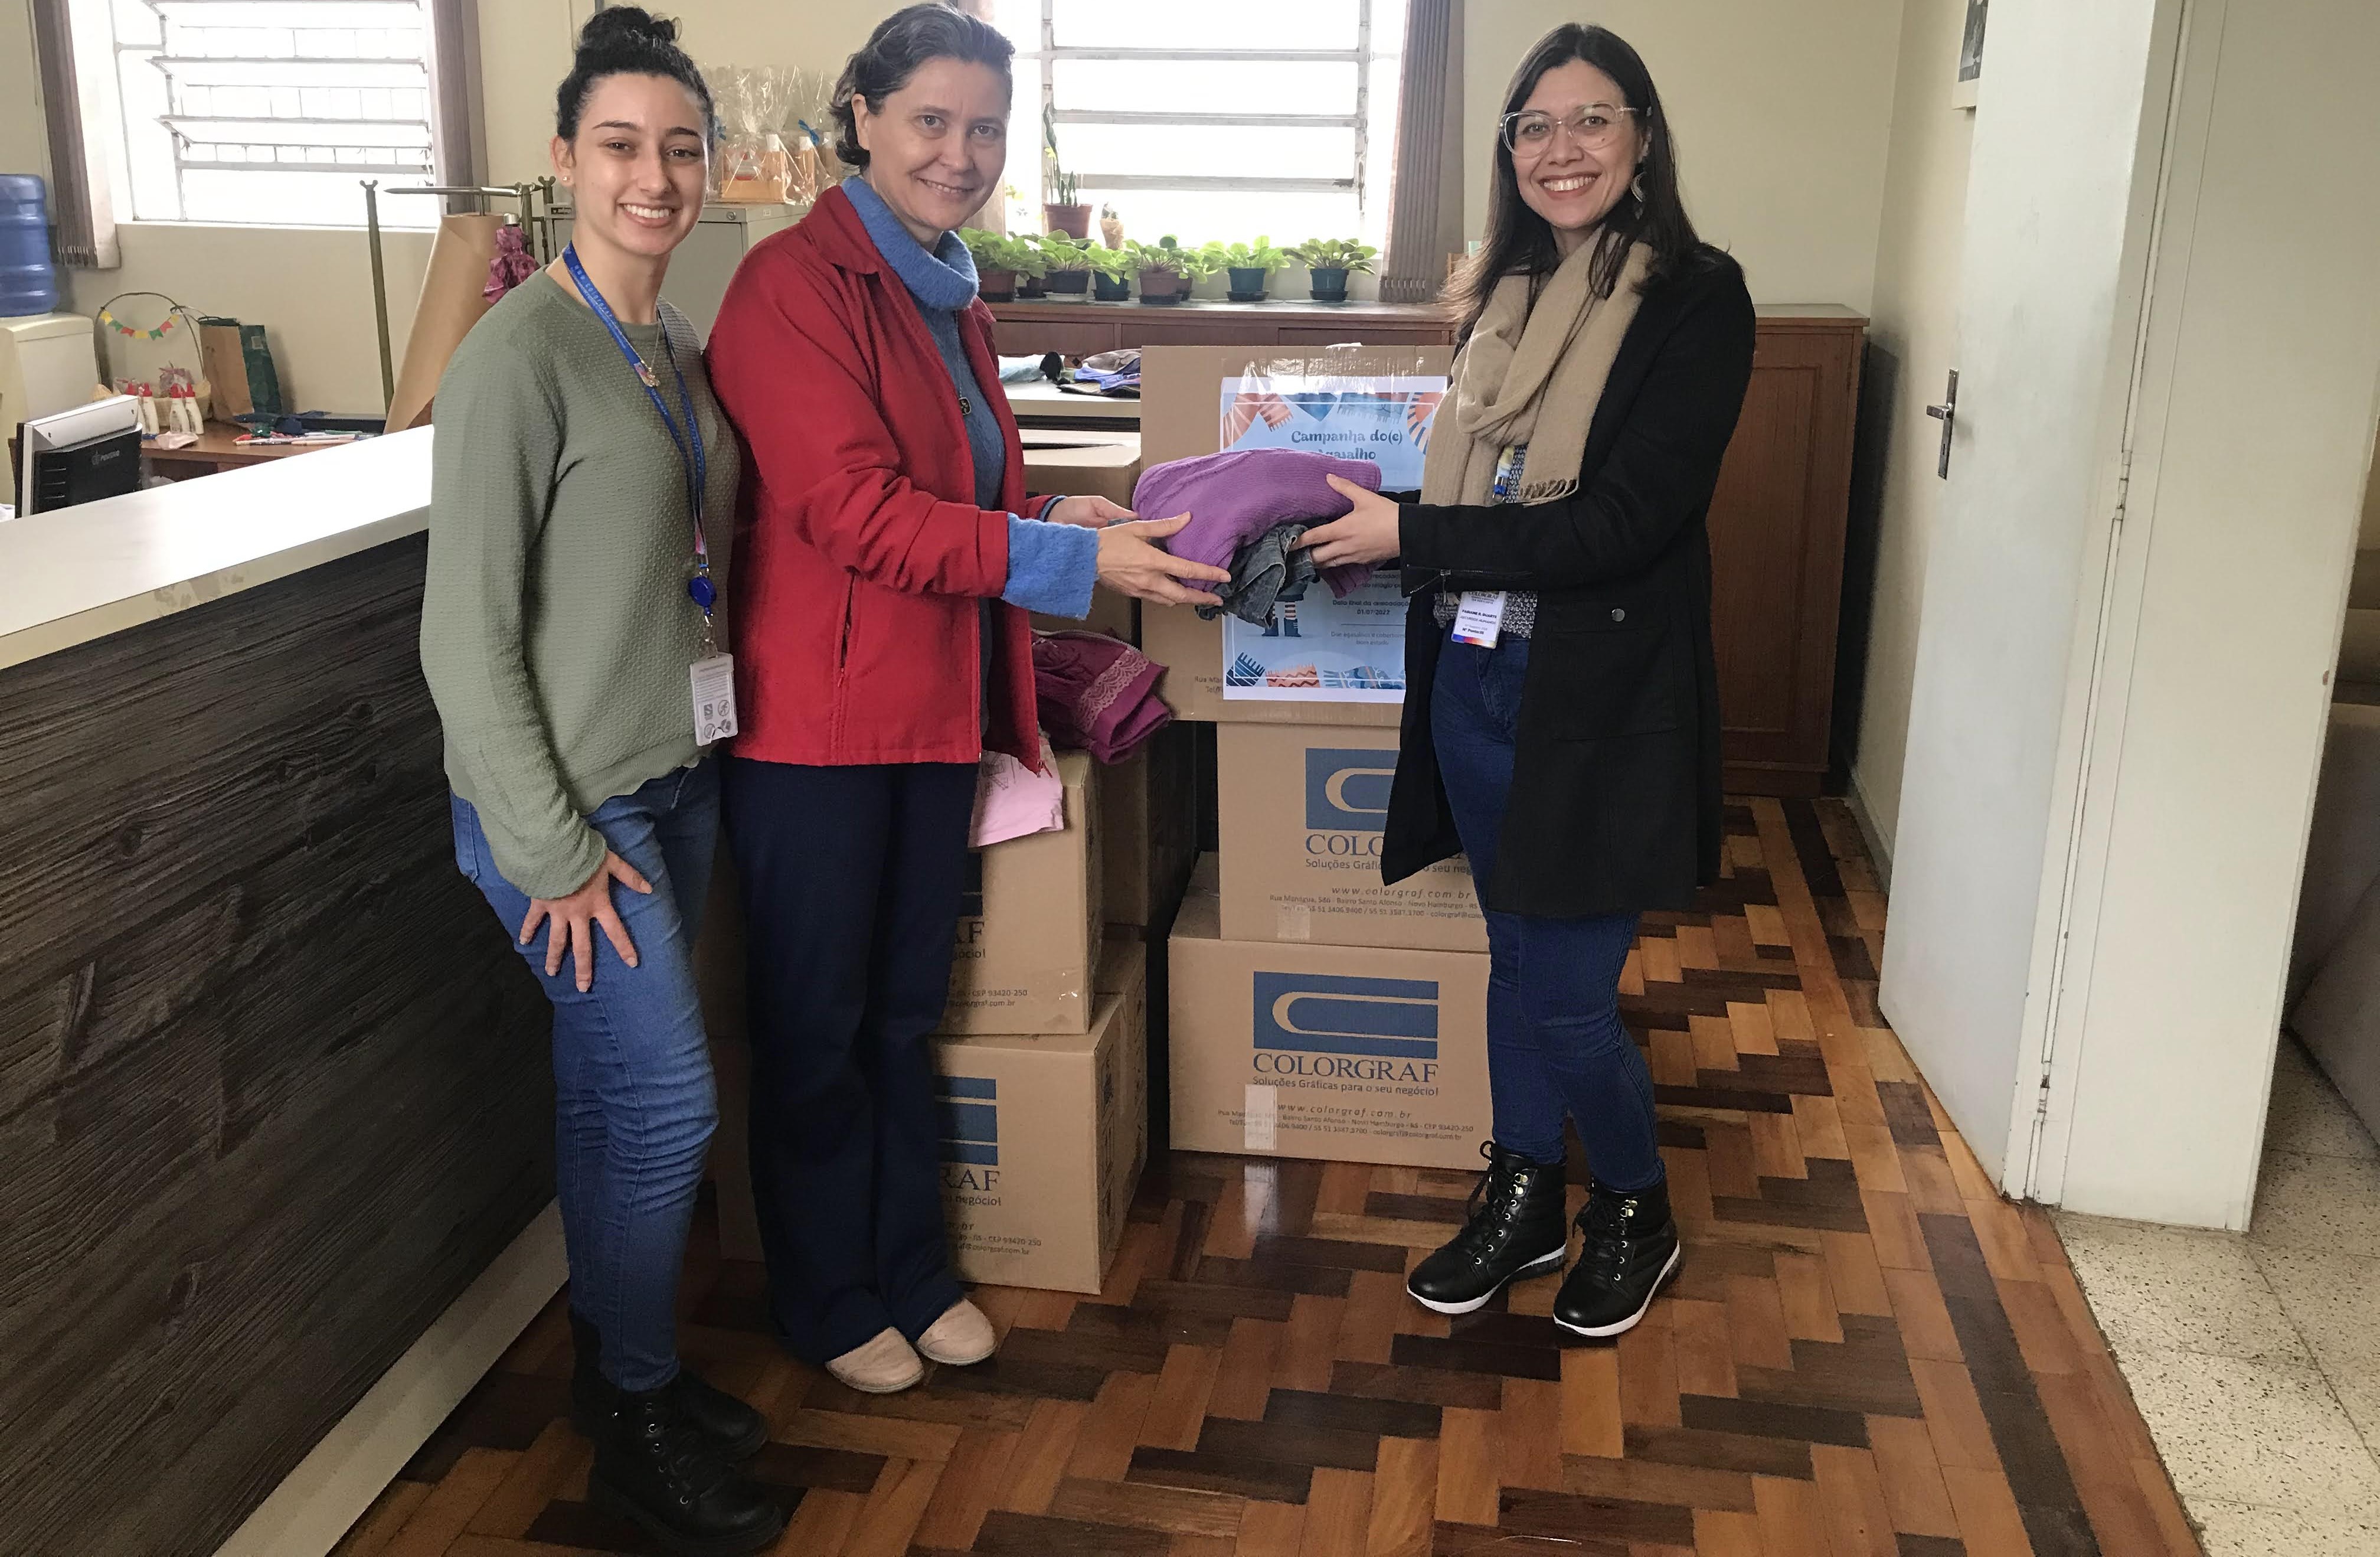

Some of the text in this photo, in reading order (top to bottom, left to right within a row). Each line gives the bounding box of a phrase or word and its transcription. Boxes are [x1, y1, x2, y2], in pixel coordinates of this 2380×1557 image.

[1291, 429, 1402, 445] Campanha do(e)
[1306, 859, 1351, 871] Soluções
[1427, 901, 1463, 910] Hamburgo
[1253, 1053, 1439, 1083] COLORGRAF
[1252, 1076, 1296, 1088] Soluções
[1299, 1078, 1338, 1091] Gráficas
[1341, 1083, 1363, 1093] para
[1395, 1085, 1439, 1097] negócio!
[1438, 1124, 1475, 1132] 93420-250
